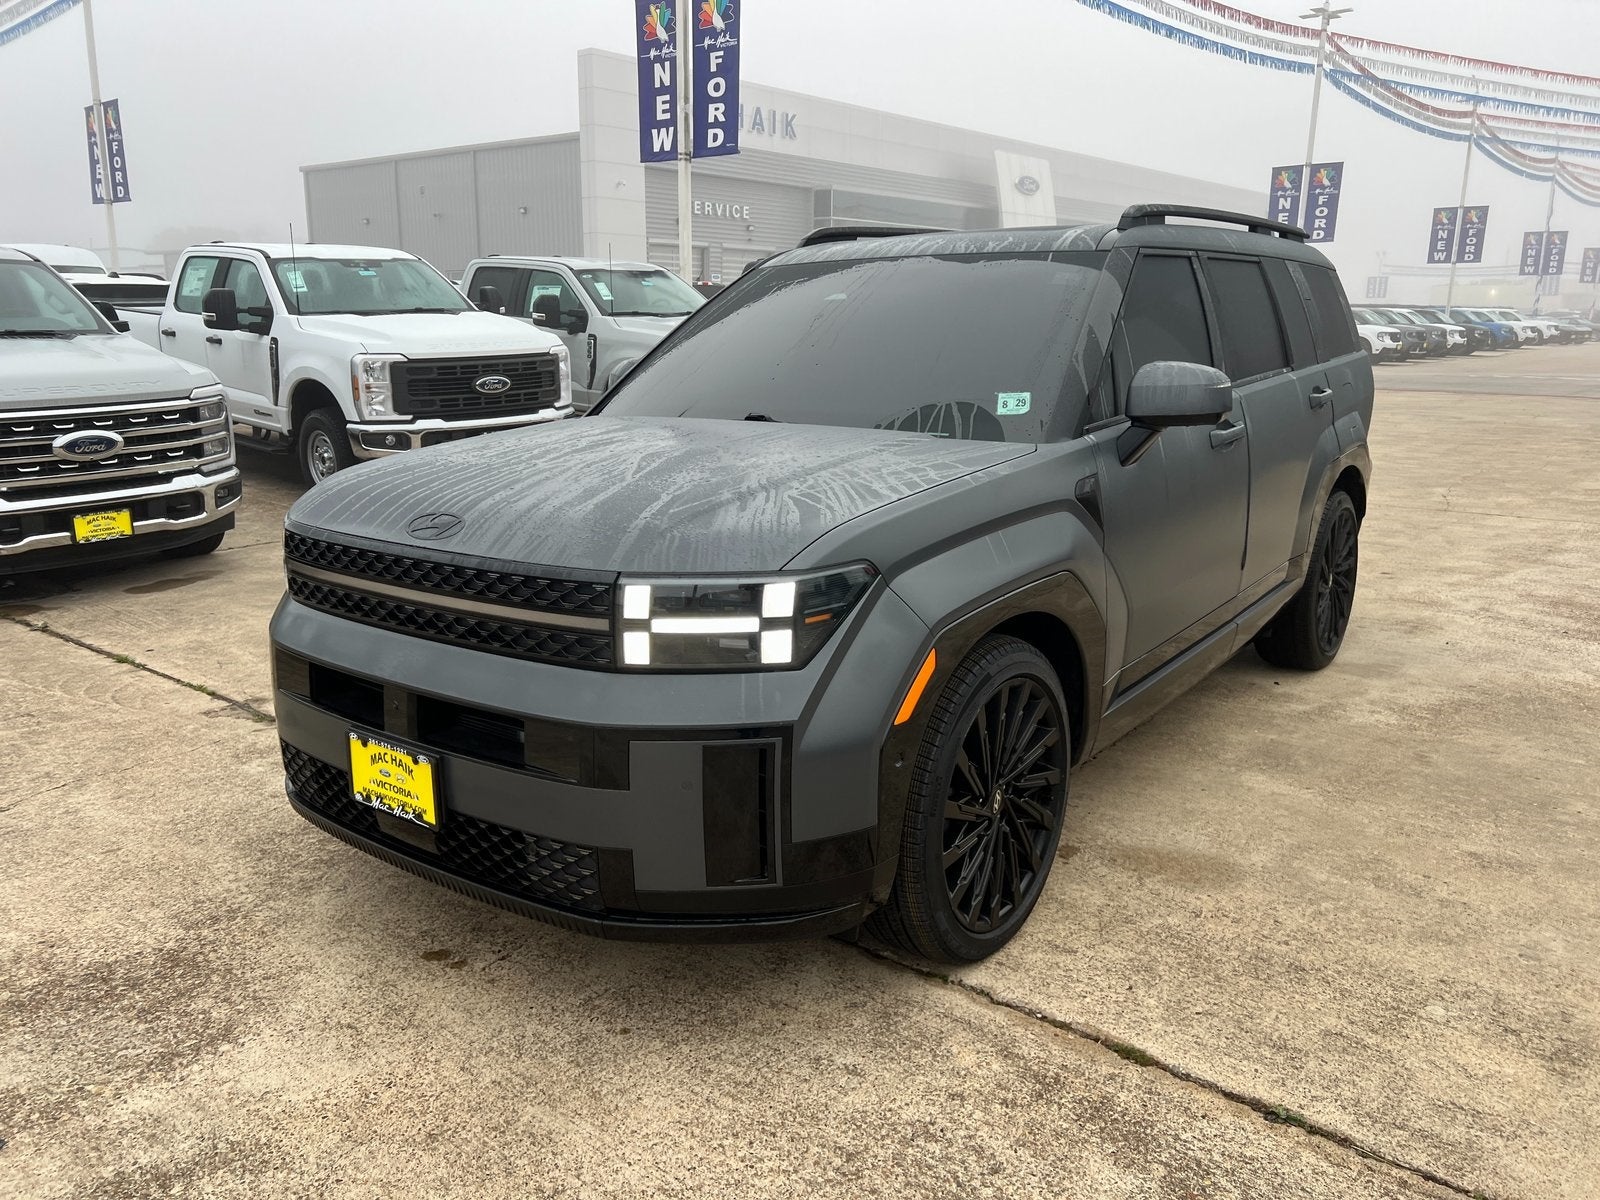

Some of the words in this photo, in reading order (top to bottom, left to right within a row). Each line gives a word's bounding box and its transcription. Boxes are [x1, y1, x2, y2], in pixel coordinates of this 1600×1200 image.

[651, 61, 674, 152] NEW
[706, 51, 726, 148] FORD
[112, 142, 125, 198] FORD
[693, 200, 750, 219] ERVICE
[1277, 197, 1291, 225] NE
[1312, 195, 1329, 240] FORD
[1433, 229, 1448, 262] NEW
[1464, 228, 1477, 261] FORD
[1524, 248, 1537, 273] NEW
[1548, 248, 1559, 273] FORD
[484, 379, 503, 390] Ford
[1002, 400, 1008, 409] 8
[1015, 398, 1027, 407] 29
[74, 438, 107, 453] Ford
[370, 752, 389, 767] MAC
[390, 754, 415, 781] HAIK
[367, 797, 393, 813] Mac
[393, 805, 422, 822] Haik
